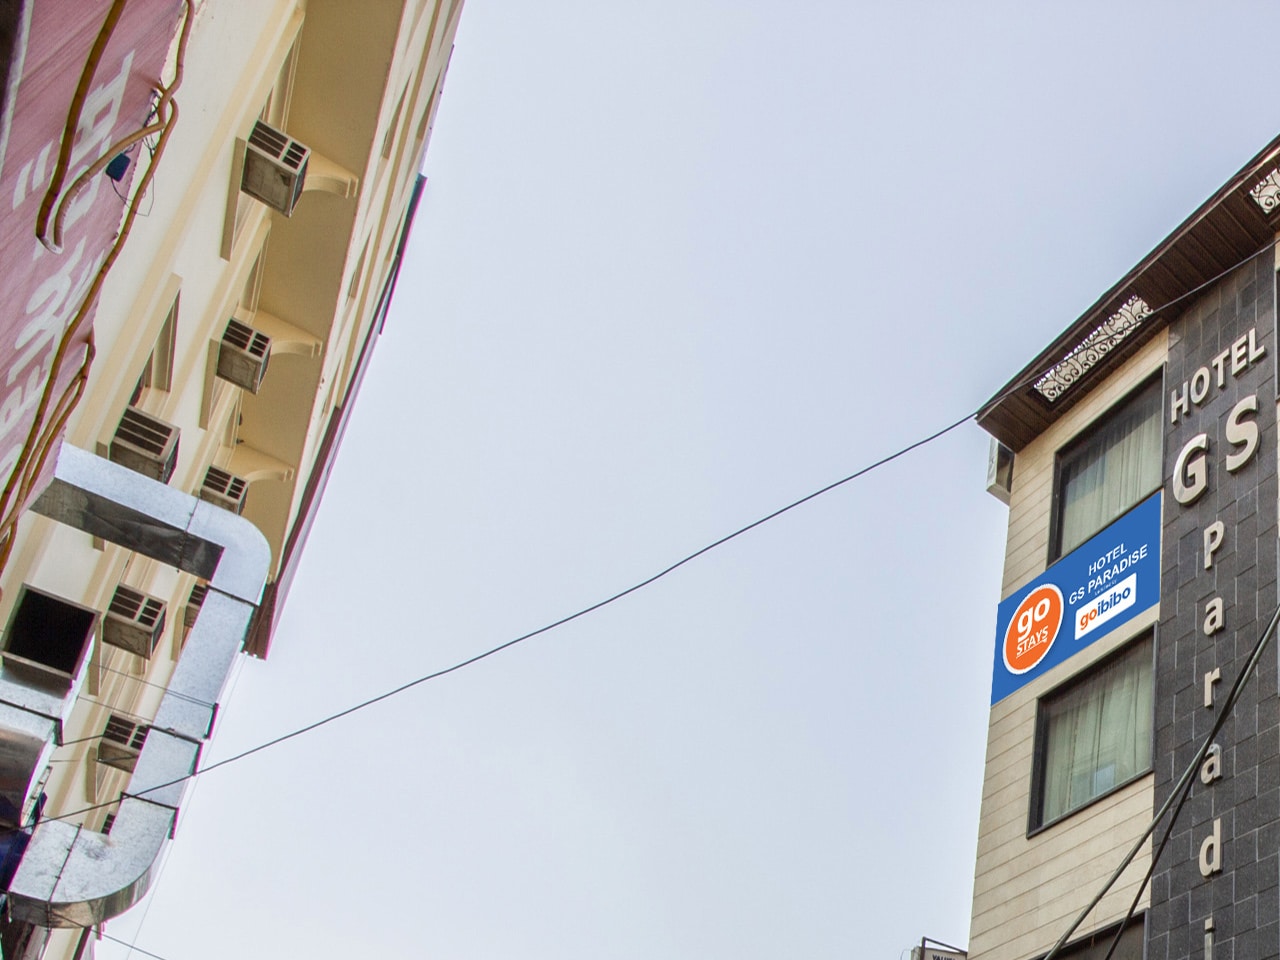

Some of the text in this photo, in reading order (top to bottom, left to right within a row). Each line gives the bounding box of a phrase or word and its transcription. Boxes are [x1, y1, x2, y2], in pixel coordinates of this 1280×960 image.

[1171, 328, 1265, 425] HOTEL
[1172, 394, 1262, 506] GS
[1068, 586, 1085, 605] GS
[1087, 544, 1149, 594] PARADISE
[1088, 543, 1127, 576] HOTEL
[1017, 597, 1051, 643] go
[1079, 586, 1131, 631] goibibo
[1016, 625, 1049, 656] STAYS
